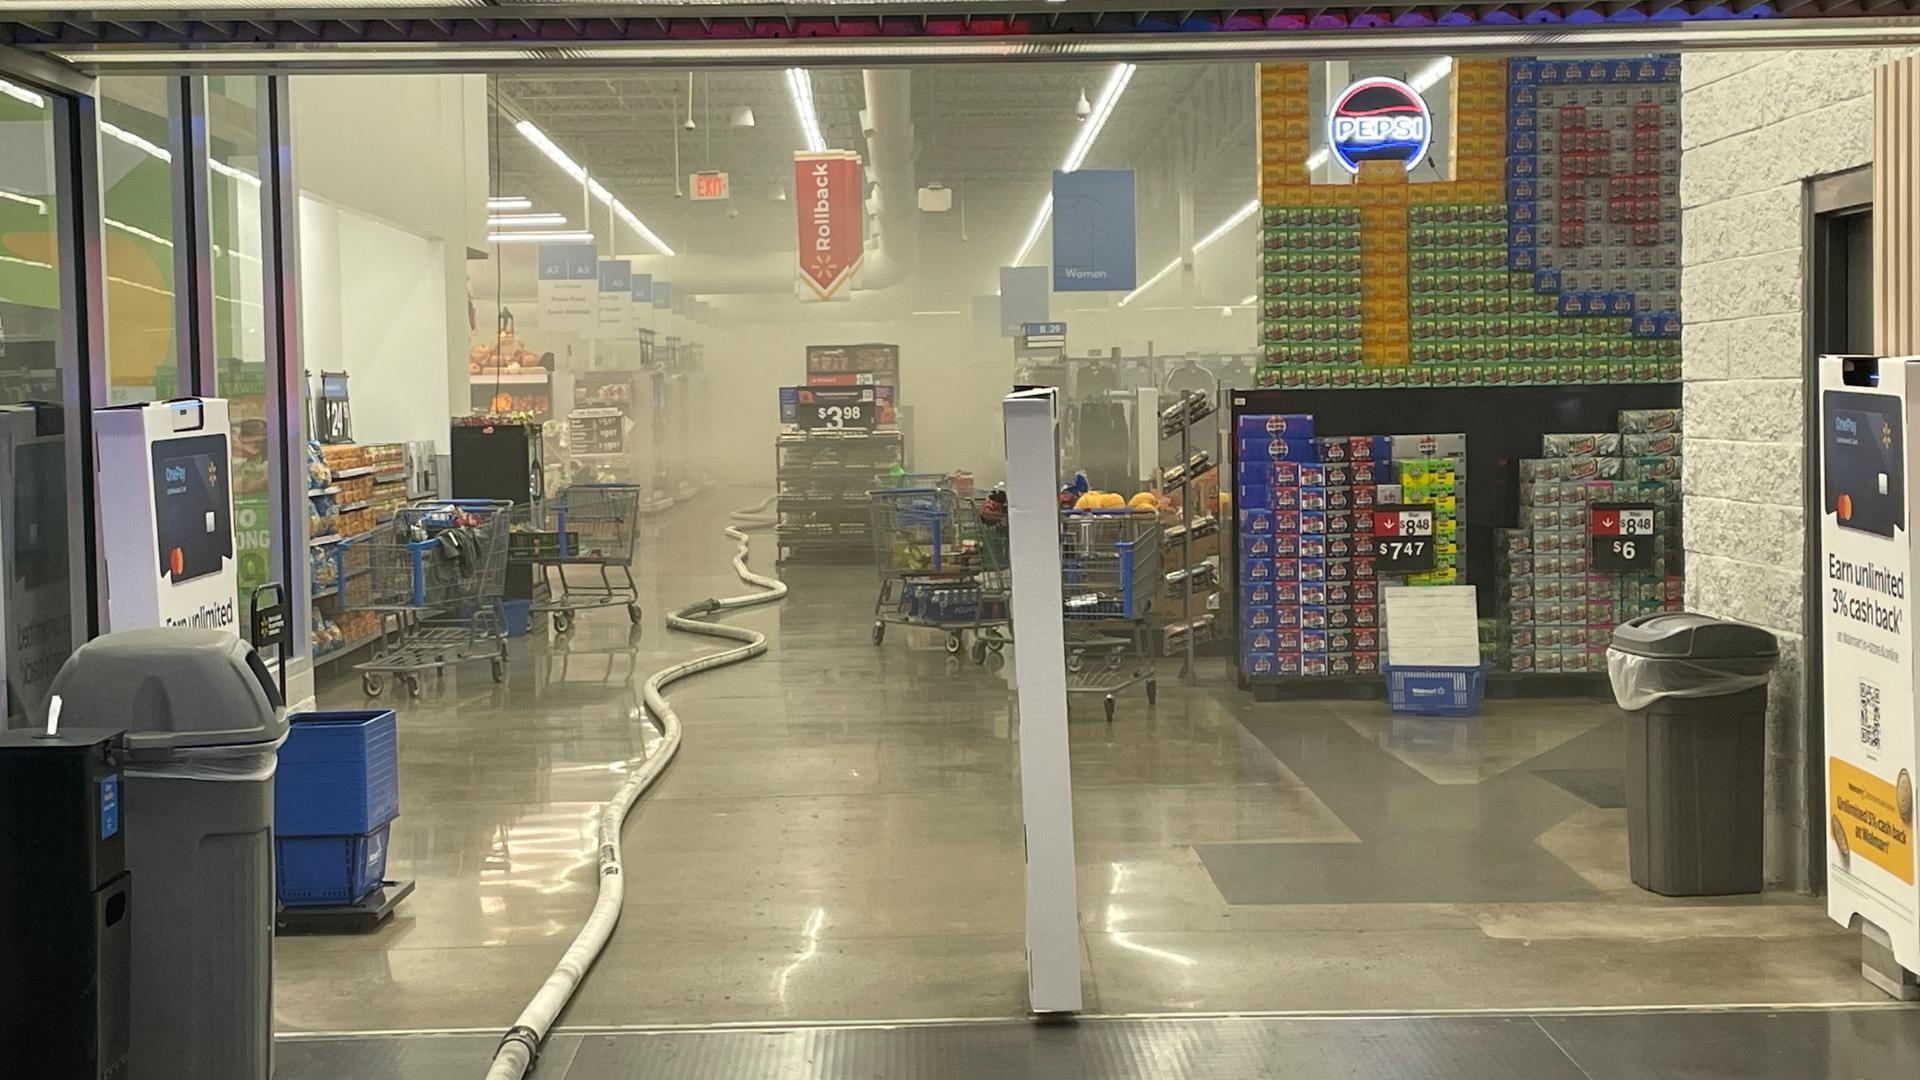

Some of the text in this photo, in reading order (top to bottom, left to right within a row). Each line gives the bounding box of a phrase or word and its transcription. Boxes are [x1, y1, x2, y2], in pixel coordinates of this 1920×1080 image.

[1335, 116, 1423, 142] PEPSI
[696, 176, 723, 197] EXIT
[812, 163, 831, 251] Rollback
[546, 265, 560, 275] A2
[577, 265, 590, 275] A3
[1065, 268, 1107, 279] Women
[1049, 324, 1061, 333] 29
[1380, 542, 1424, 560] $747
[1613, 541, 1636, 560] $6
[1829, 552, 1904, 600] Earn unlimited
[1832, 588, 1848, 617] 3%
[1850, 597, 1874, 626] cash
